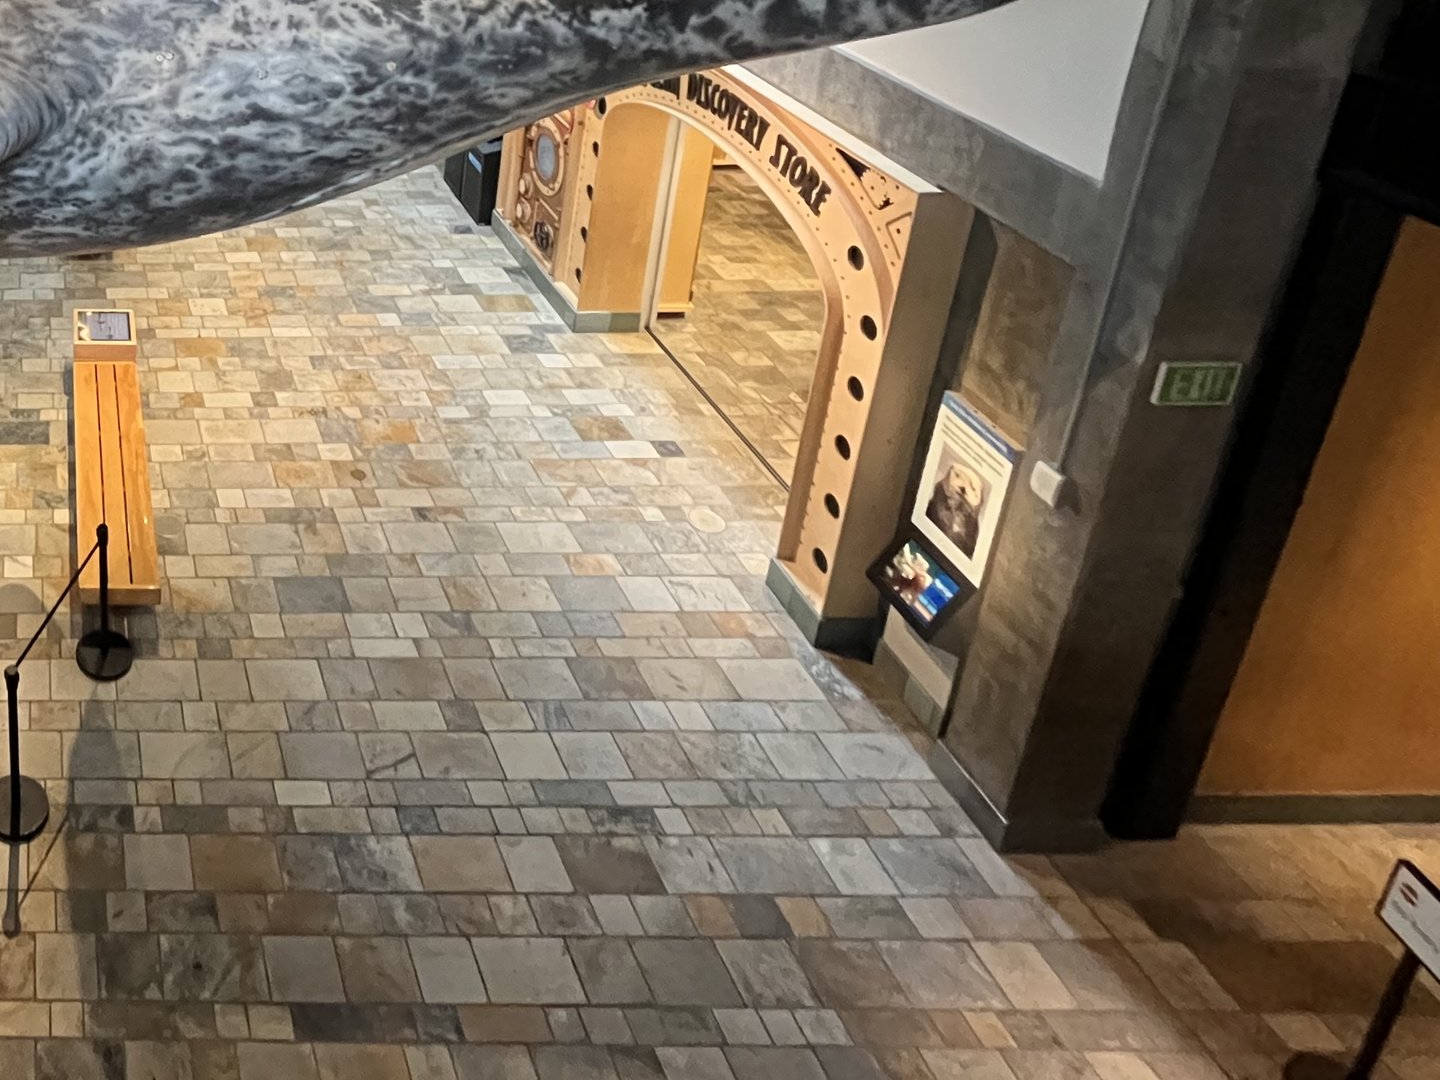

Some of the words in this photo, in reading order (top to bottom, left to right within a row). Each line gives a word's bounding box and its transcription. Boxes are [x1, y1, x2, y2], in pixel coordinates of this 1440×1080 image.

[687, 73, 771, 151] DISCOVERY
[769, 134, 832, 217] STORE
[1169, 368, 1231, 401] EXIT
